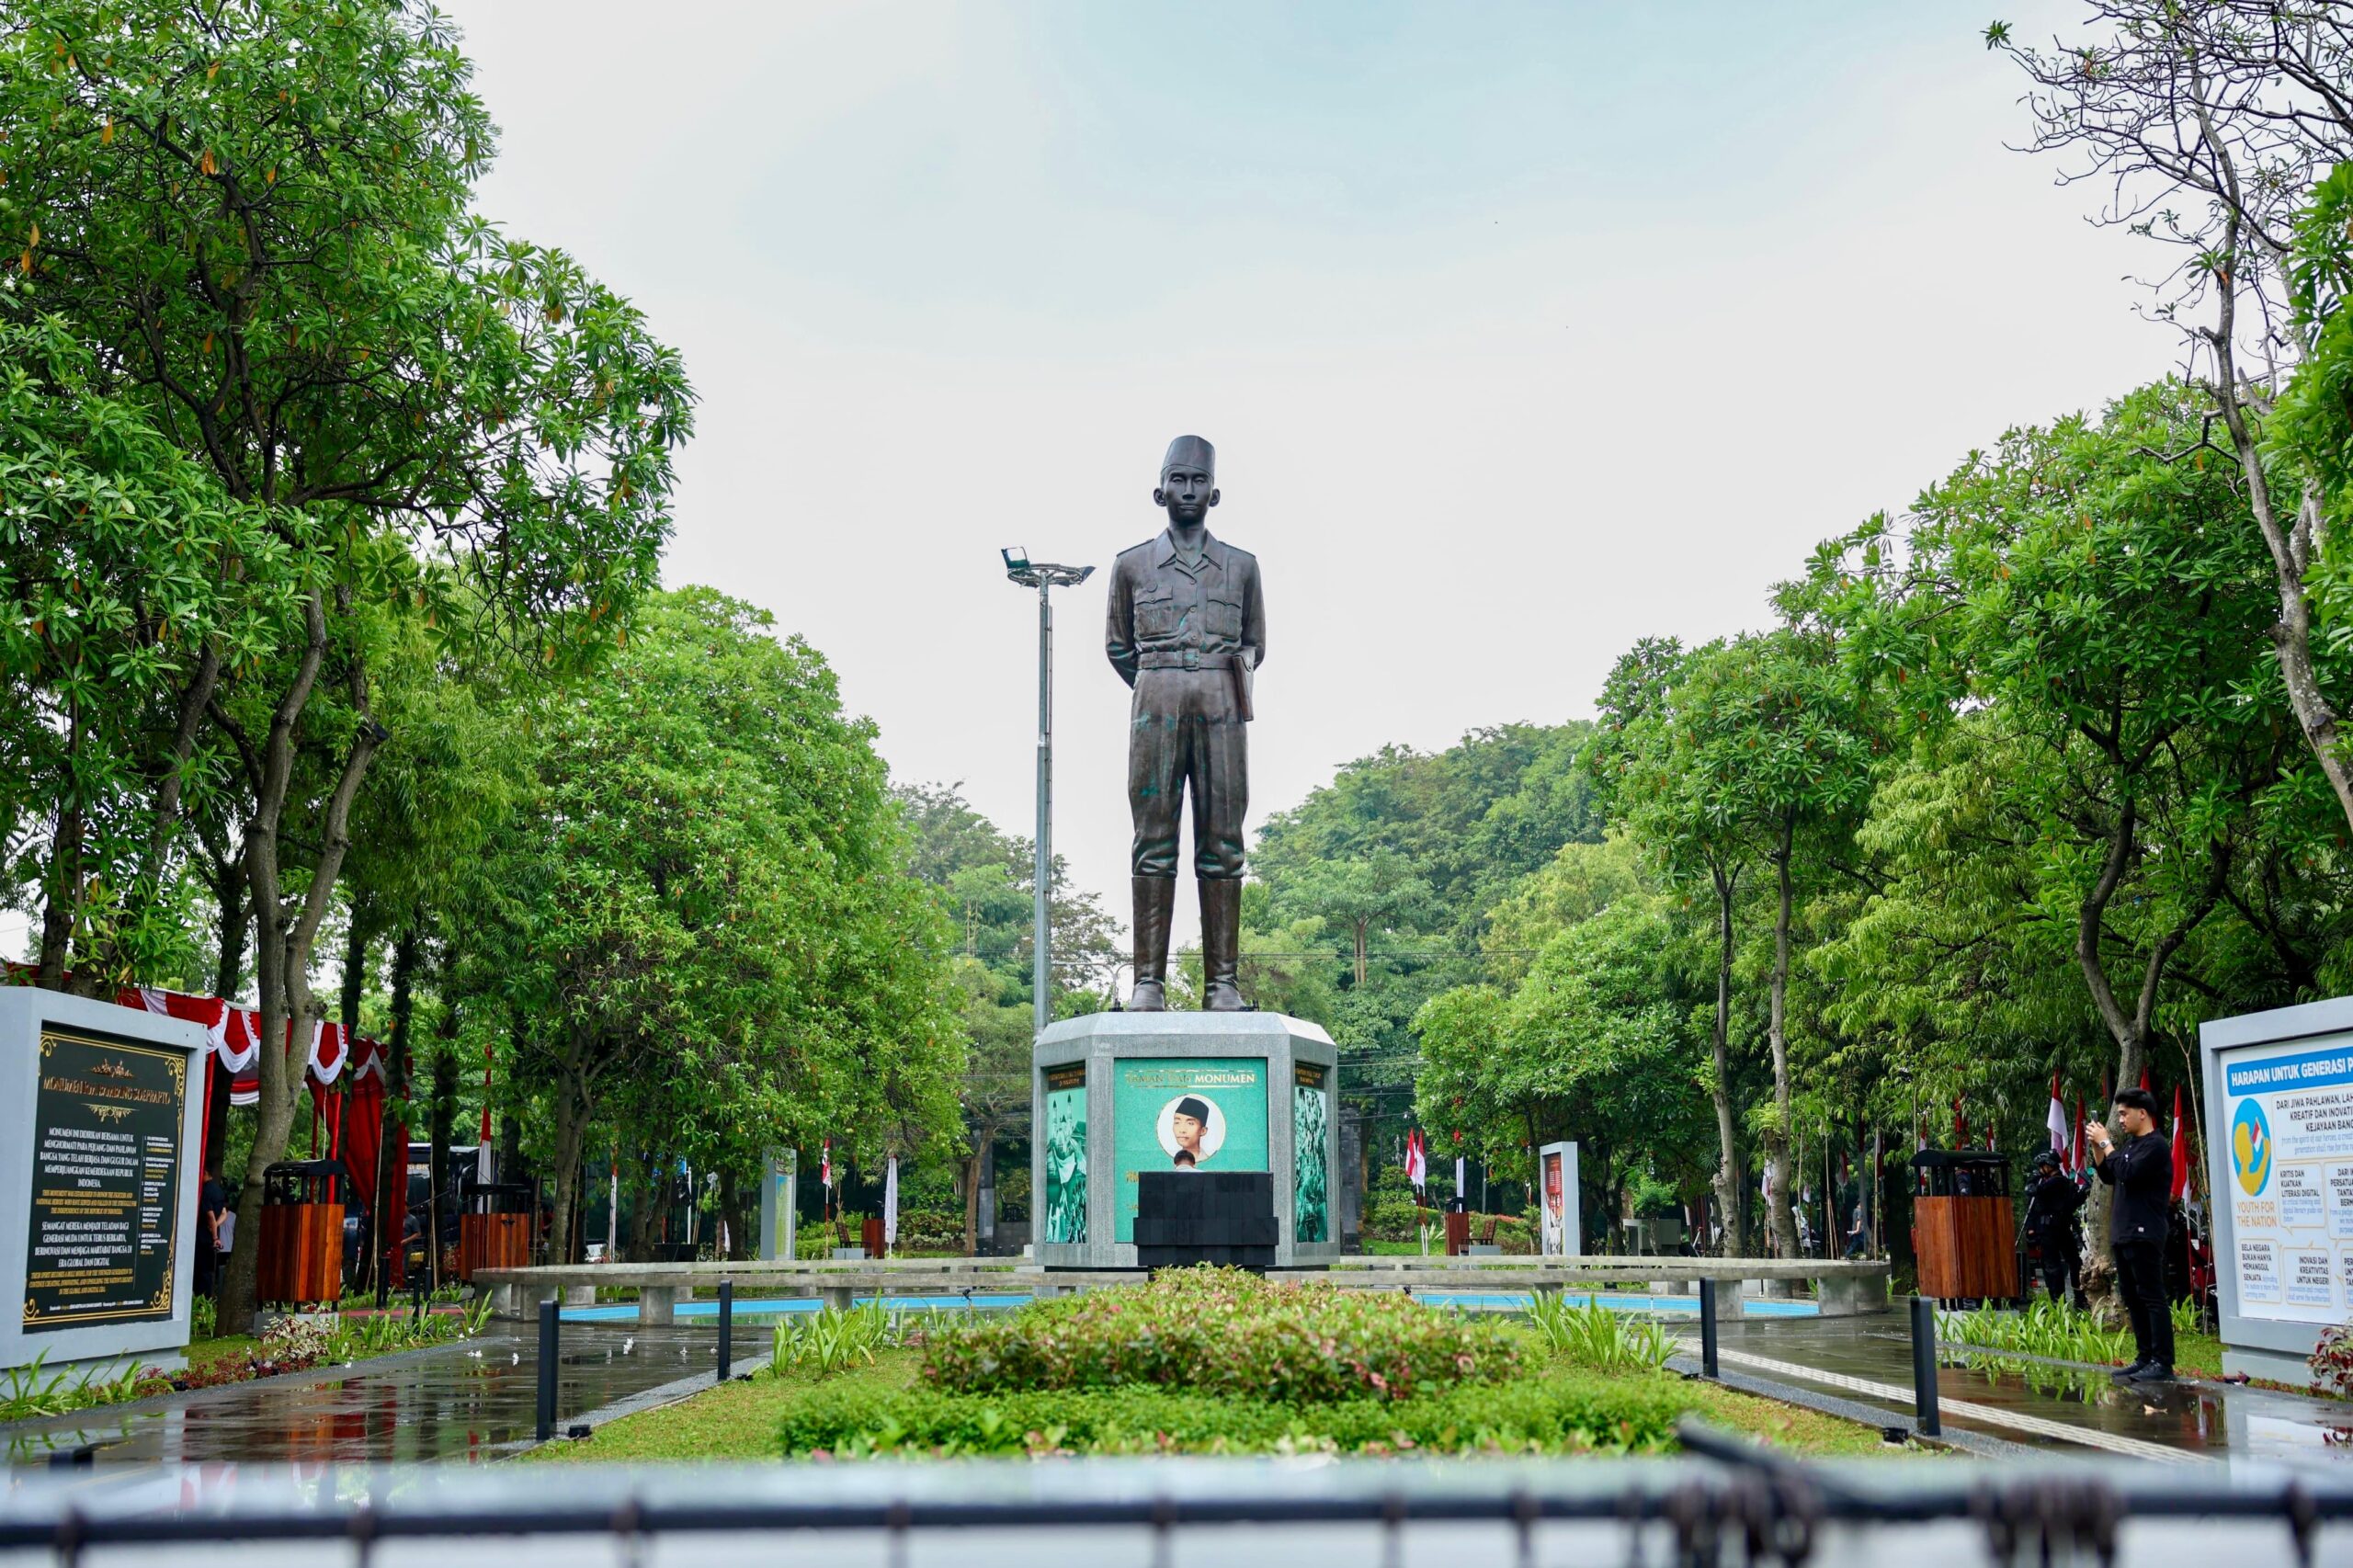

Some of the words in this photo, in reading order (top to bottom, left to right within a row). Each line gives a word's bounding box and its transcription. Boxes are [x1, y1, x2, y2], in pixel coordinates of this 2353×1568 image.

[2232, 1068, 2271, 1086] HARAPAN
[2271, 1064, 2300, 1081] UNTUK
[2301, 1058, 2347, 1078] GENERASI
[1195, 1074, 1256, 1084] MONUMEN
[43, 1077, 83, 1094] MONUMEN
[132, 1087, 171, 1104] SOEPRAPTO
[2277, 1099, 2290, 1110] DARI
[2290, 1097, 2305, 1108] JIWA
[2290, 1109, 2313, 1120] KREATIF
[2315, 1108, 2327, 1119] DAN
[2306, 1121, 2336, 1132] KEJAYAAN
[49, 1127, 73, 1137] MONUMEN
[119, 1133, 133, 1142] UNTUK
[107, 1144, 115, 1153] DAN
[40, 1152, 57, 1161] BANGSA
[58, 1153, 70, 1162] YANG
[71, 1153, 84, 1163] TELAH
[2337, 1168, 2348, 1176] DARI
[2281, 1189, 2301, 1198] LITERASI
[2302, 1188, 2320, 1197] DIGITAL
[2237, 1201, 2259, 1212] YOUTH
[2261, 1201, 2275, 1212] FOR
[41, 1221, 65, 1231] SEMANGAT
[65, 1221, 83, 1230] MEREKA
[2236, 1216, 2250, 1227] THE
[2251, 1216, 2277, 1228] NATION
[42, 1233, 64, 1243] GENERASI
[78, 1234, 92, 1243] UNTUK
[61, 1246, 70, 1255] DAN
[58, 1259, 66, 1267] ERA
[67, 1258, 84, 1267] GLOBAL
[84, 1258, 94, 1267] DAN
[2299, 1256, 2317, 1265] INOVASI
[2318, 1256, 2328, 1265] DAN
[2243, 1263, 2269, 1271] MEMANGGUL
[2300, 1267, 2328, 1275] KREATIVITAS
[2296, 1276, 2311, 1284] UNTUK
[2313, 1277, 2329, 1285] NEGERI
